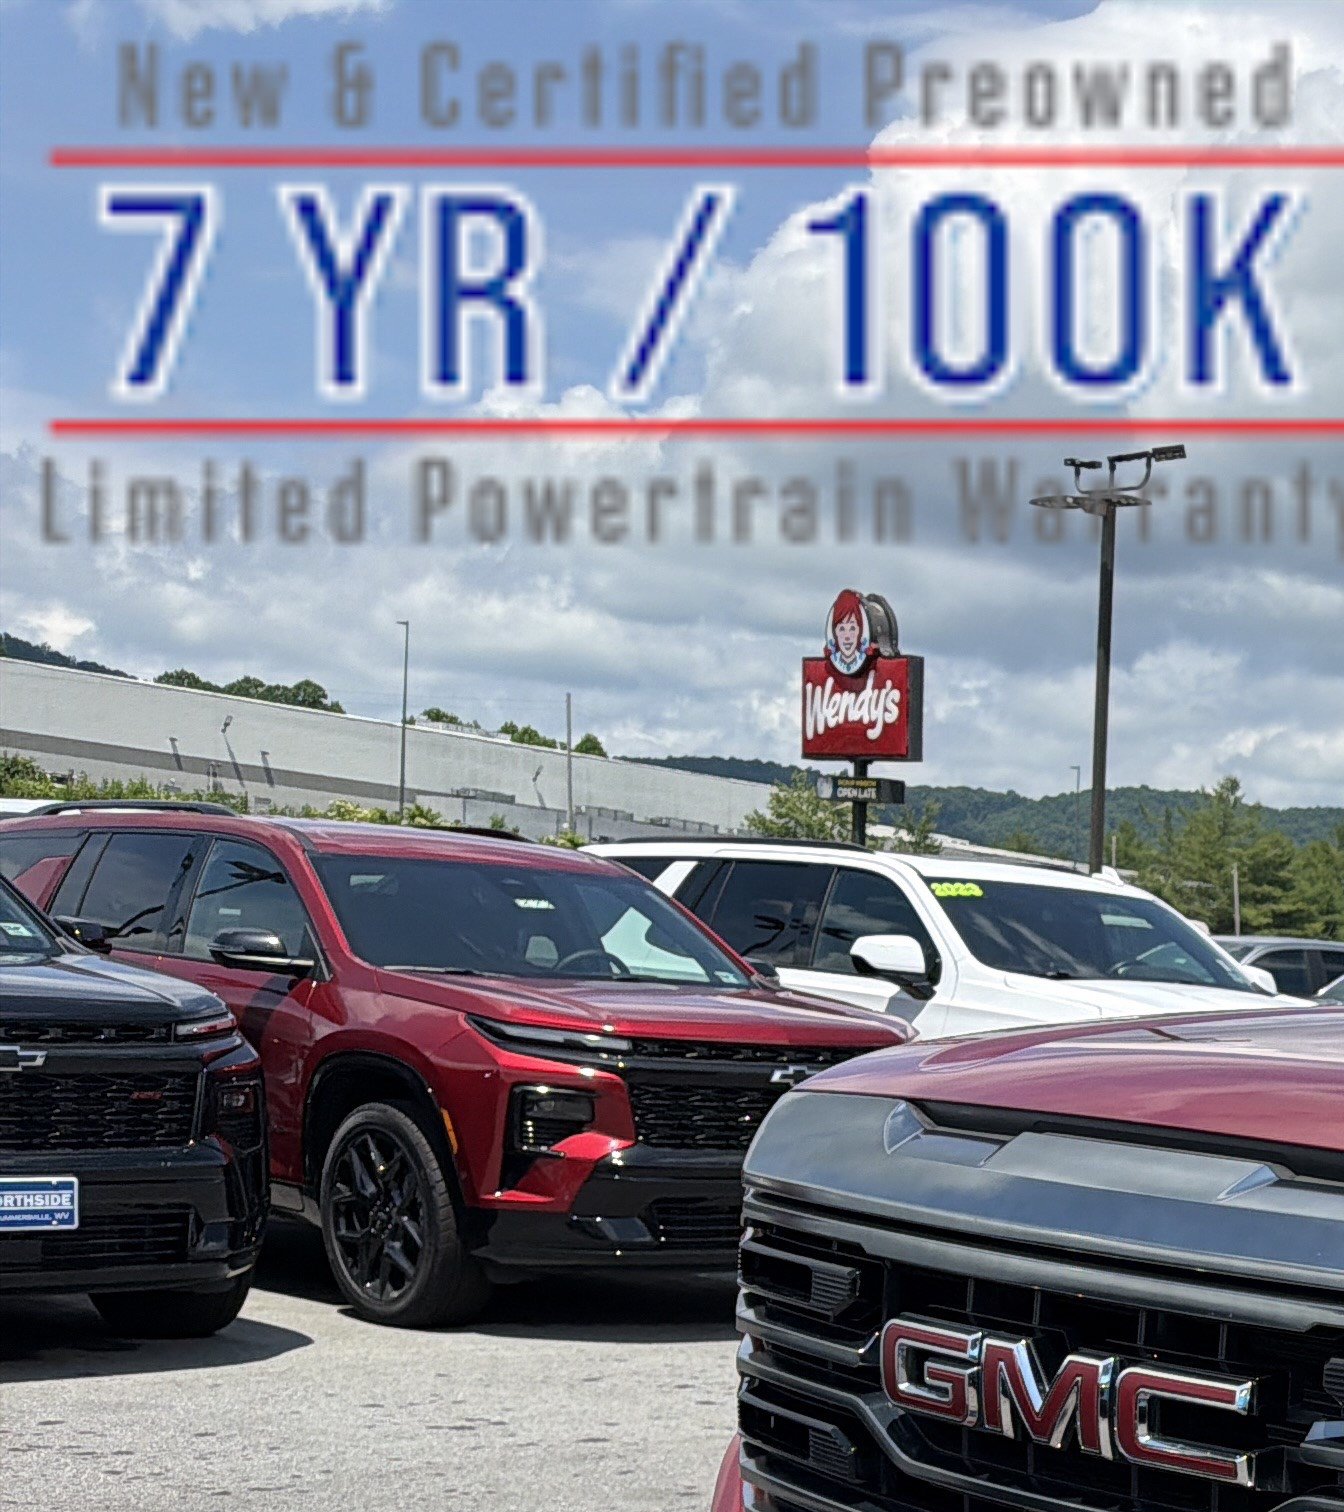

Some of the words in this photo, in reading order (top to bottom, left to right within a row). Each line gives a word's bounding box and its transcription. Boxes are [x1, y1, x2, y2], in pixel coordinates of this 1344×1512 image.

[805, 669, 901, 740] Wendy's
[0, 1193, 72, 1207] RTHSIDE
[880, 1317, 1257, 1489] GMC
